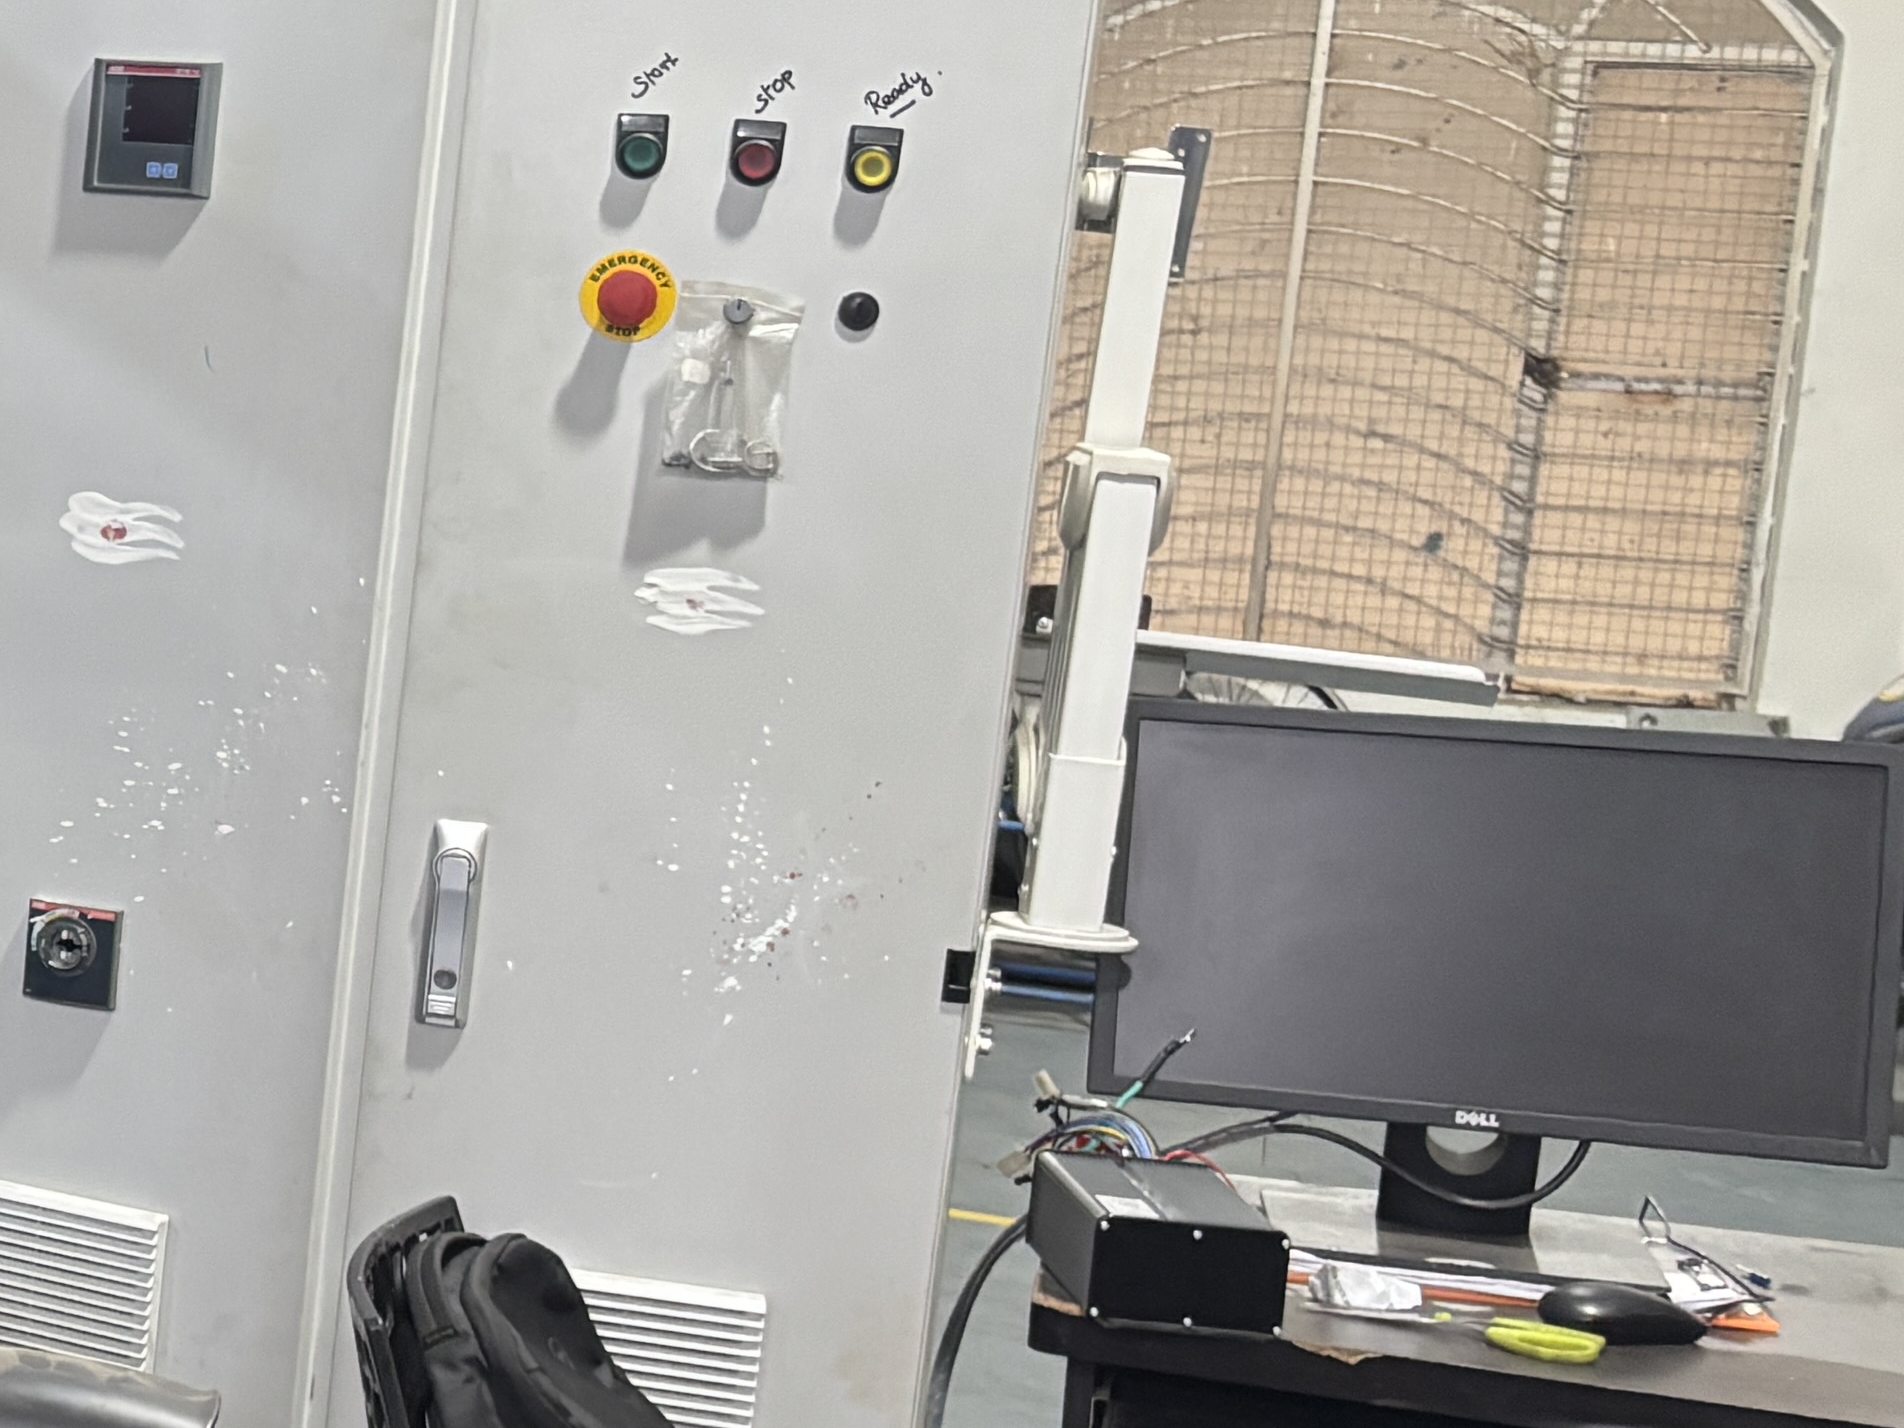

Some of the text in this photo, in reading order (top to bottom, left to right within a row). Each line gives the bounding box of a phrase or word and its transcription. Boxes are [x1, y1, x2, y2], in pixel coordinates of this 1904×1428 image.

[588, 254, 672, 291] EMERGENCY
[605, 324, 641, 338] STOP
[1454, 1109, 1500, 1128] DELL
